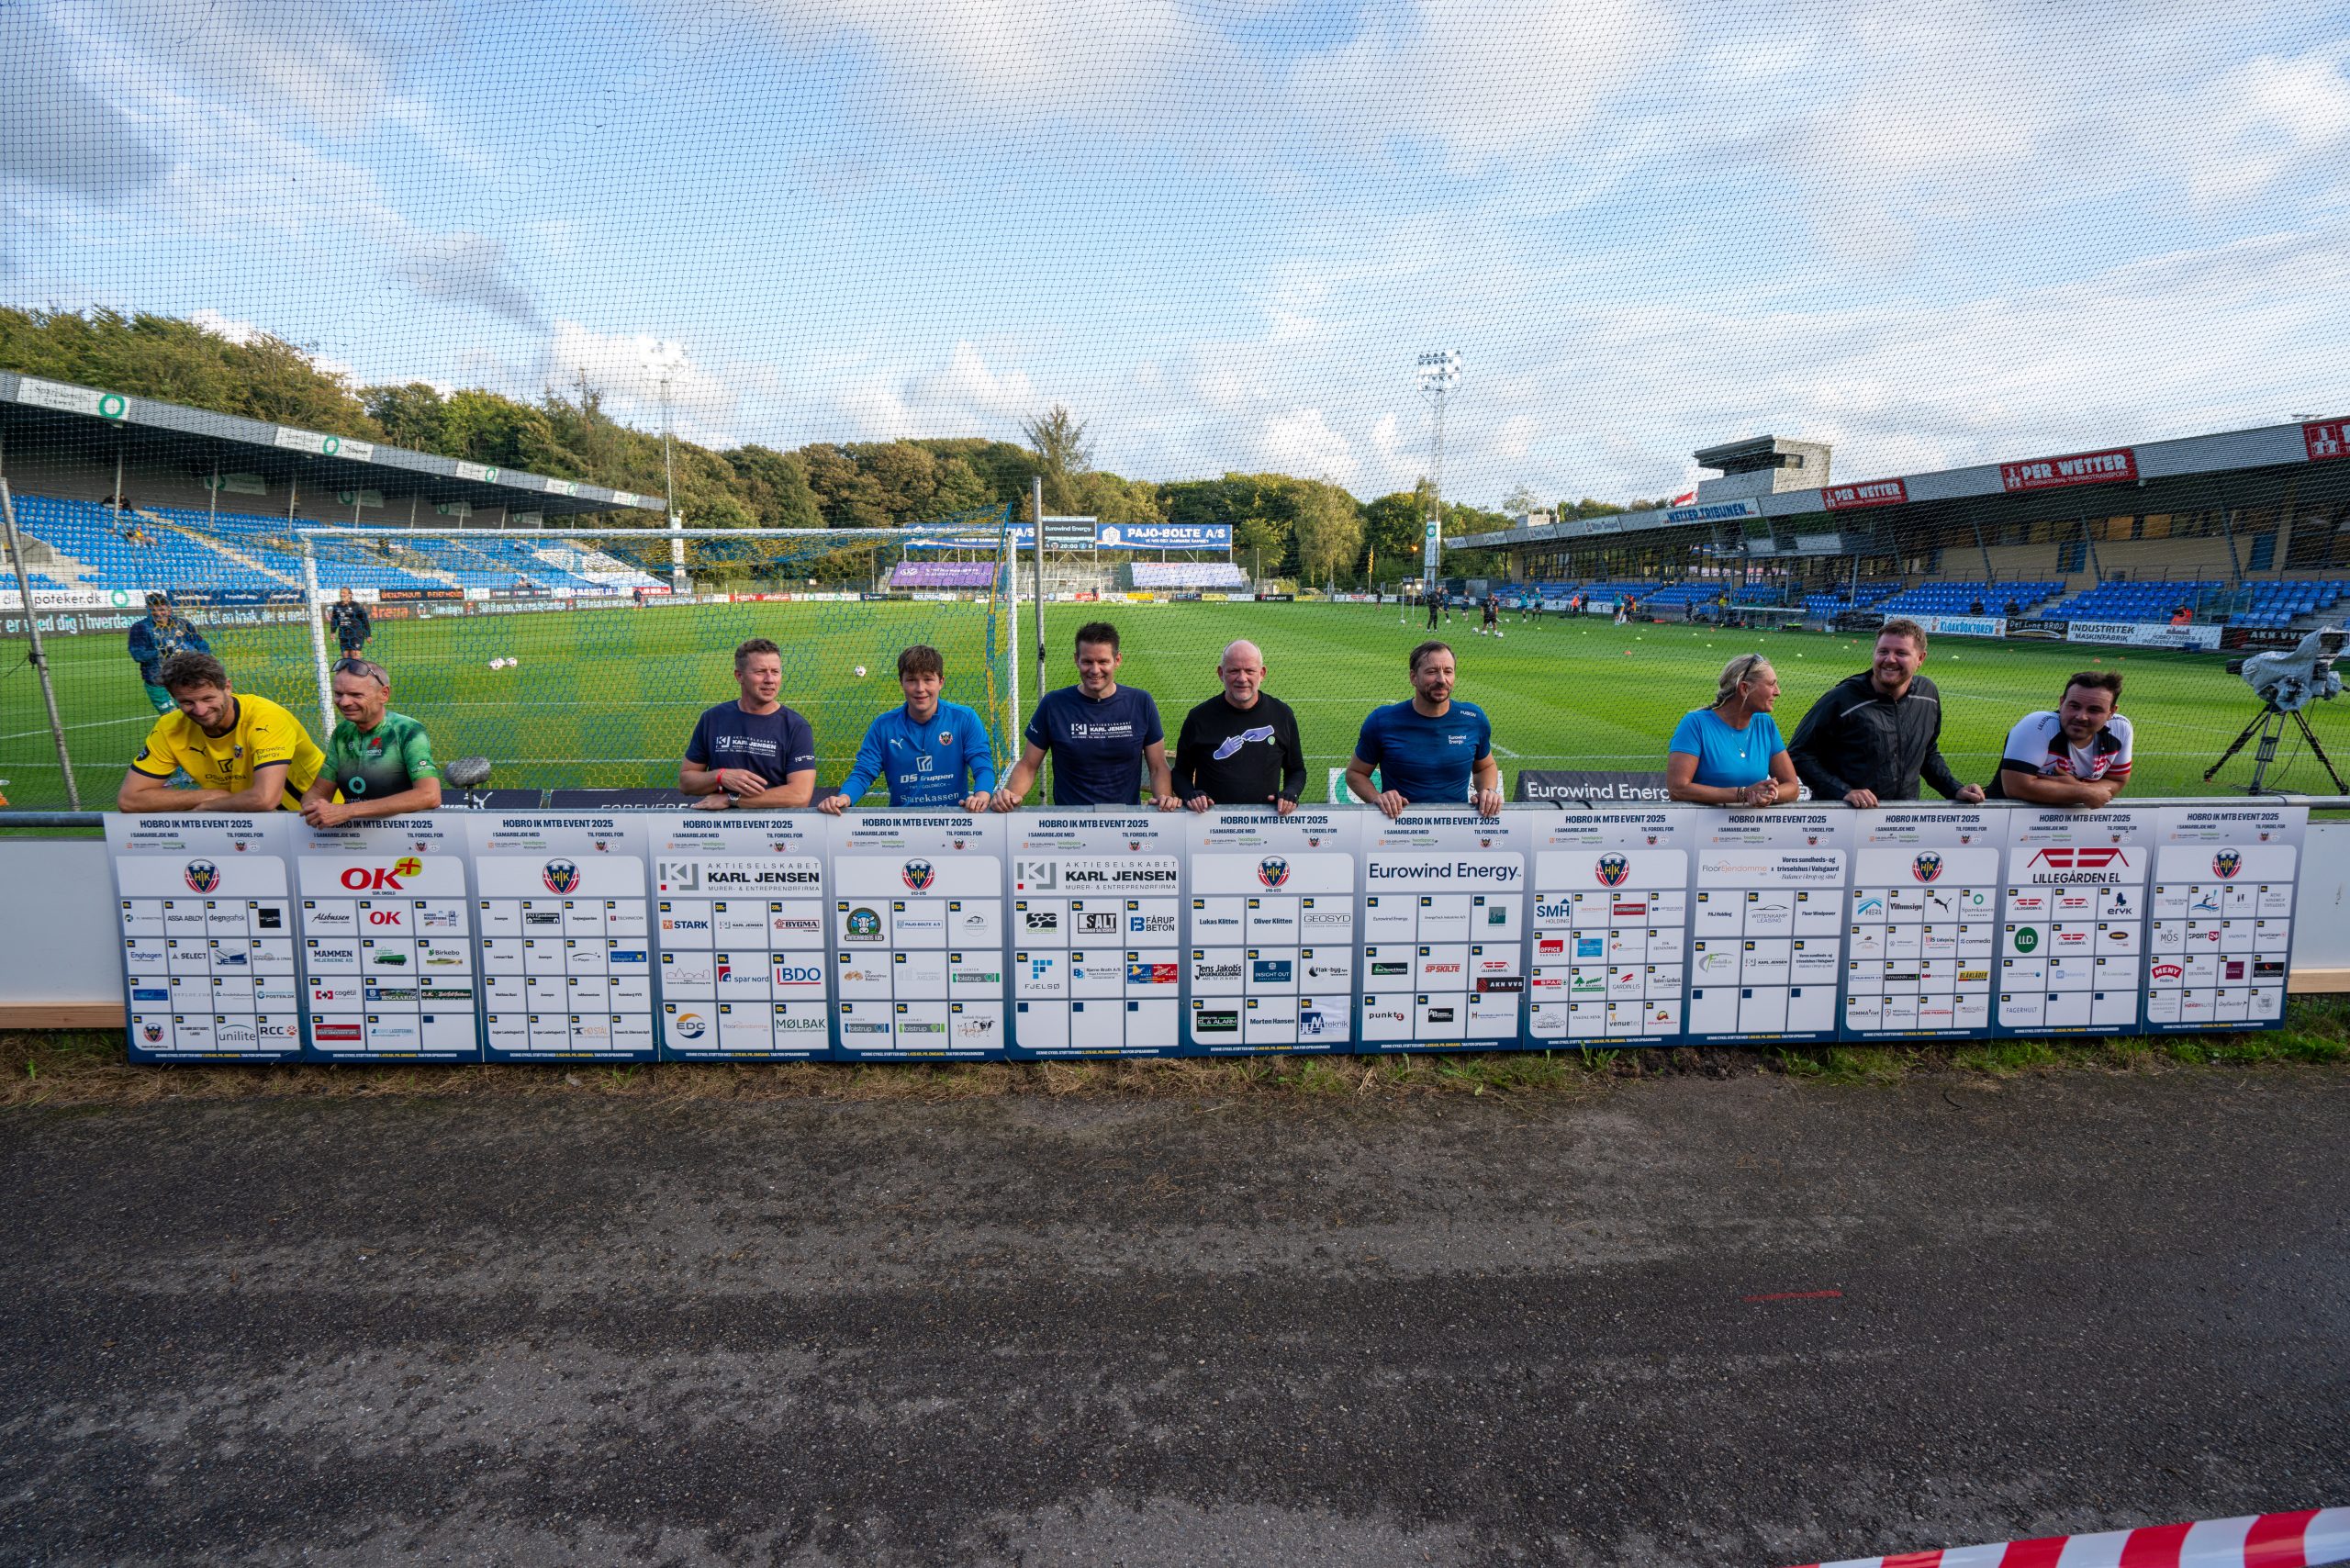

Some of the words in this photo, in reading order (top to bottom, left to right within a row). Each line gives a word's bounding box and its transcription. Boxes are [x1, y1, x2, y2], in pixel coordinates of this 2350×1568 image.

[2021, 464, 2053, 480] PER
[2057, 454, 2128, 476] WETTER
[1836, 489, 1853, 501] PER
[1857, 483, 1901, 498] WETTER
[1699, 503, 1747, 520] TRIBUNEN
[1127, 528, 1201, 538] PAJO-BOLTE
[1206, 528, 1225, 539] A/S
[1940, 622, 1994, 634] KLOAKDOKTOREN
[2071, 624, 2134, 633] INDUSTRITEK
[256, 746, 285, 755] Eurowind
[257, 752, 280, 760] Energy
[901, 774, 918, 783] DS
[1528, 782, 1614, 798] Eurowind
[1619, 783, 1672, 801] Energ
[1220, 816, 1249, 824] HOBRO
[1250, 816, 1259, 824] IK
[1259, 816, 1279, 824] MTB
[1280, 816, 1306, 824] EVENT
[1307, 816, 1328, 824] 2025
[1394, 817, 1424, 825] HOBRO
[1424, 817, 1433, 825] IK
[1433, 817, 1452, 825] MTB
[1452, 817, 1479, 825] EVENT
[1479, 817, 1500, 825] 2025
[1729, 815, 1755, 823] HOBRO
[1756, 815, 1763, 823] IK
[1764, 815, 1782, 823] MTB
[1783, 815, 1807, 823] EVENT
[1807, 815, 1827, 823] 2025
[2039, 814, 2065, 823] HOBRO
[2065, 814, 2072, 823] IK
[2073, 814, 2088, 823] MTB
[2089, 814, 2112, 823] EVENT
[2112, 814, 2131, 823] 2025
[2188, 812, 2213, 821] HOBRO
[2213, 812, 2221, 821] IK
[2221, 812, 2237, 821] MTB
[2238, 812, 2261, 821] EVENT
[2261, 812, 2279, 821] 2025
[140, 820, 171, 828] HOBRO
[172, 820, 181, 828] IK
[181, 820, 201, 828] MTB
[202, 820, 229, 828] EVENT
[230, 820, 253, 828] 2025
[502, 820, 533, 828] HOBRO
[533, 820, 543, 828] IK
[543, 820, 563, 828] MTB
[564, 820, 591, 828] EVENT
[591, 820, 613, 828] 2025
[683, 820, 712, 829] HOBRO
[713, 820, 722, 829] IK
[723, 820, 743, 829] MTB
[743, 820, 770, 829] EVENT
[771, 820, 793, 829] 2025
[862, 818, 892, 826] HOBRO
[893, 818, 901, 826] IK
[902, 818, 922, 826] MTB
[923, 818, 950, 826] EVENT
[950, 818, 973, 826] 2025
[1038, 820, 1069, 828] HOBRO
[1069, 820, 1079, 828] IK
[1079, 820, 1099, 828] MTB
[1099, 820, 1126, 828] EVENT
[1126, 820, 1149, 828] 2025
[1369, 862, 1451, 879] Eurowind
[1703, 865, 1767, 873] FloorEjendomme
[708, 872, 751, 882] KARL
[755, 872, 820, 882] JENSEN
[1066, 871, 1108, 881] KARL
[1113, 871, 1177, 881] JENSEN
[2033, 870, 2106, 883] LILLEGÅRDEN
[2109, 873, 2121, 883] EL
[1537, 905, 1570, 917] SMH
[312, 912, 350, 923] Alsbussen
[369, 912, 402, 925] OK
[1086, 914, 1116, 928] SALT
[674, 921, 708, 929] STARK
[130, 952, 162, 960] Enghagen
[782, 968, 821, 980] BDO
[776, 1019, 825, 1028] MØLBAK
[260, 1026, 284, 1036] RCC
[219, 1031, 256, 1041] unilite
